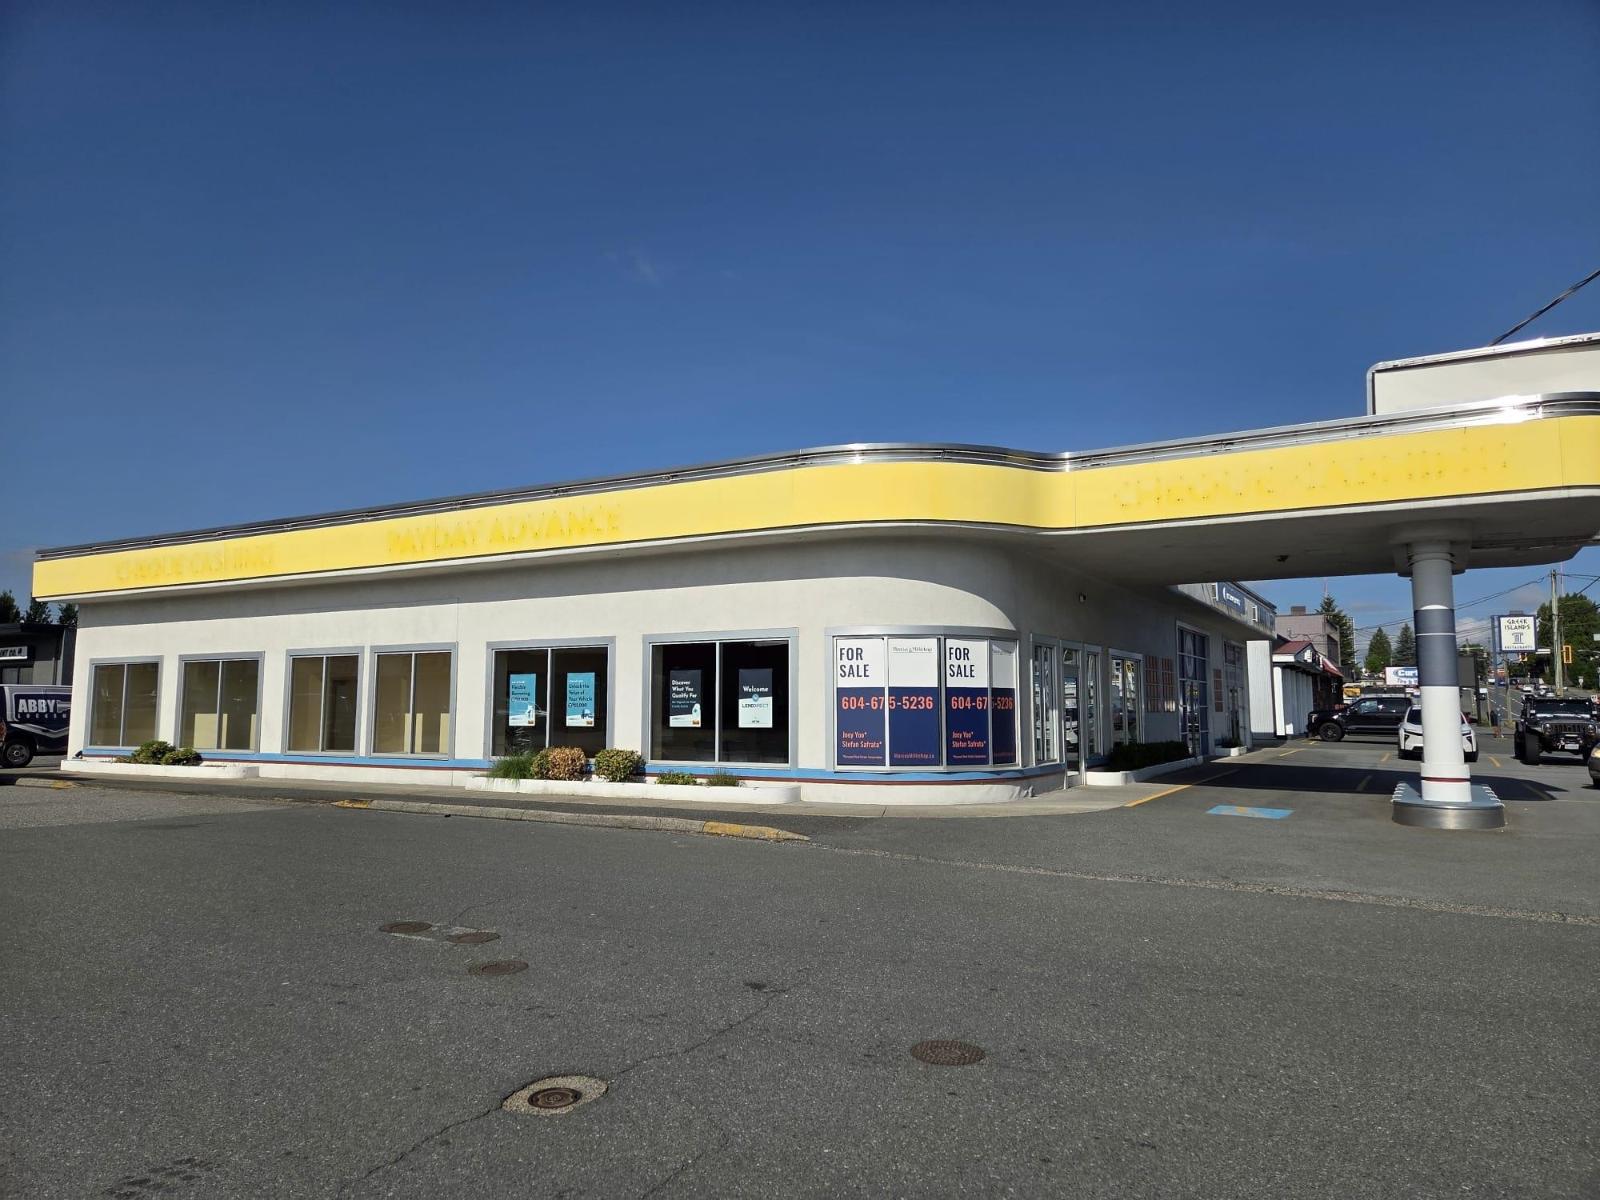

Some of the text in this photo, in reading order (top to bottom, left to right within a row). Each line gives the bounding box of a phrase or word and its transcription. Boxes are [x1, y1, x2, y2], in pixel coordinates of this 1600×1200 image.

[839, 647, 863, 661] FOR
[949, 647, 970, 661] FOR
[839, 664, 870, 678] SALE
[949, 664, 975, 678] SALE
[742, 685, 769, 693] Welcome
[18, 699, 56, 713] ABBY
[841, 696, 934, 710] 604-675-5236
